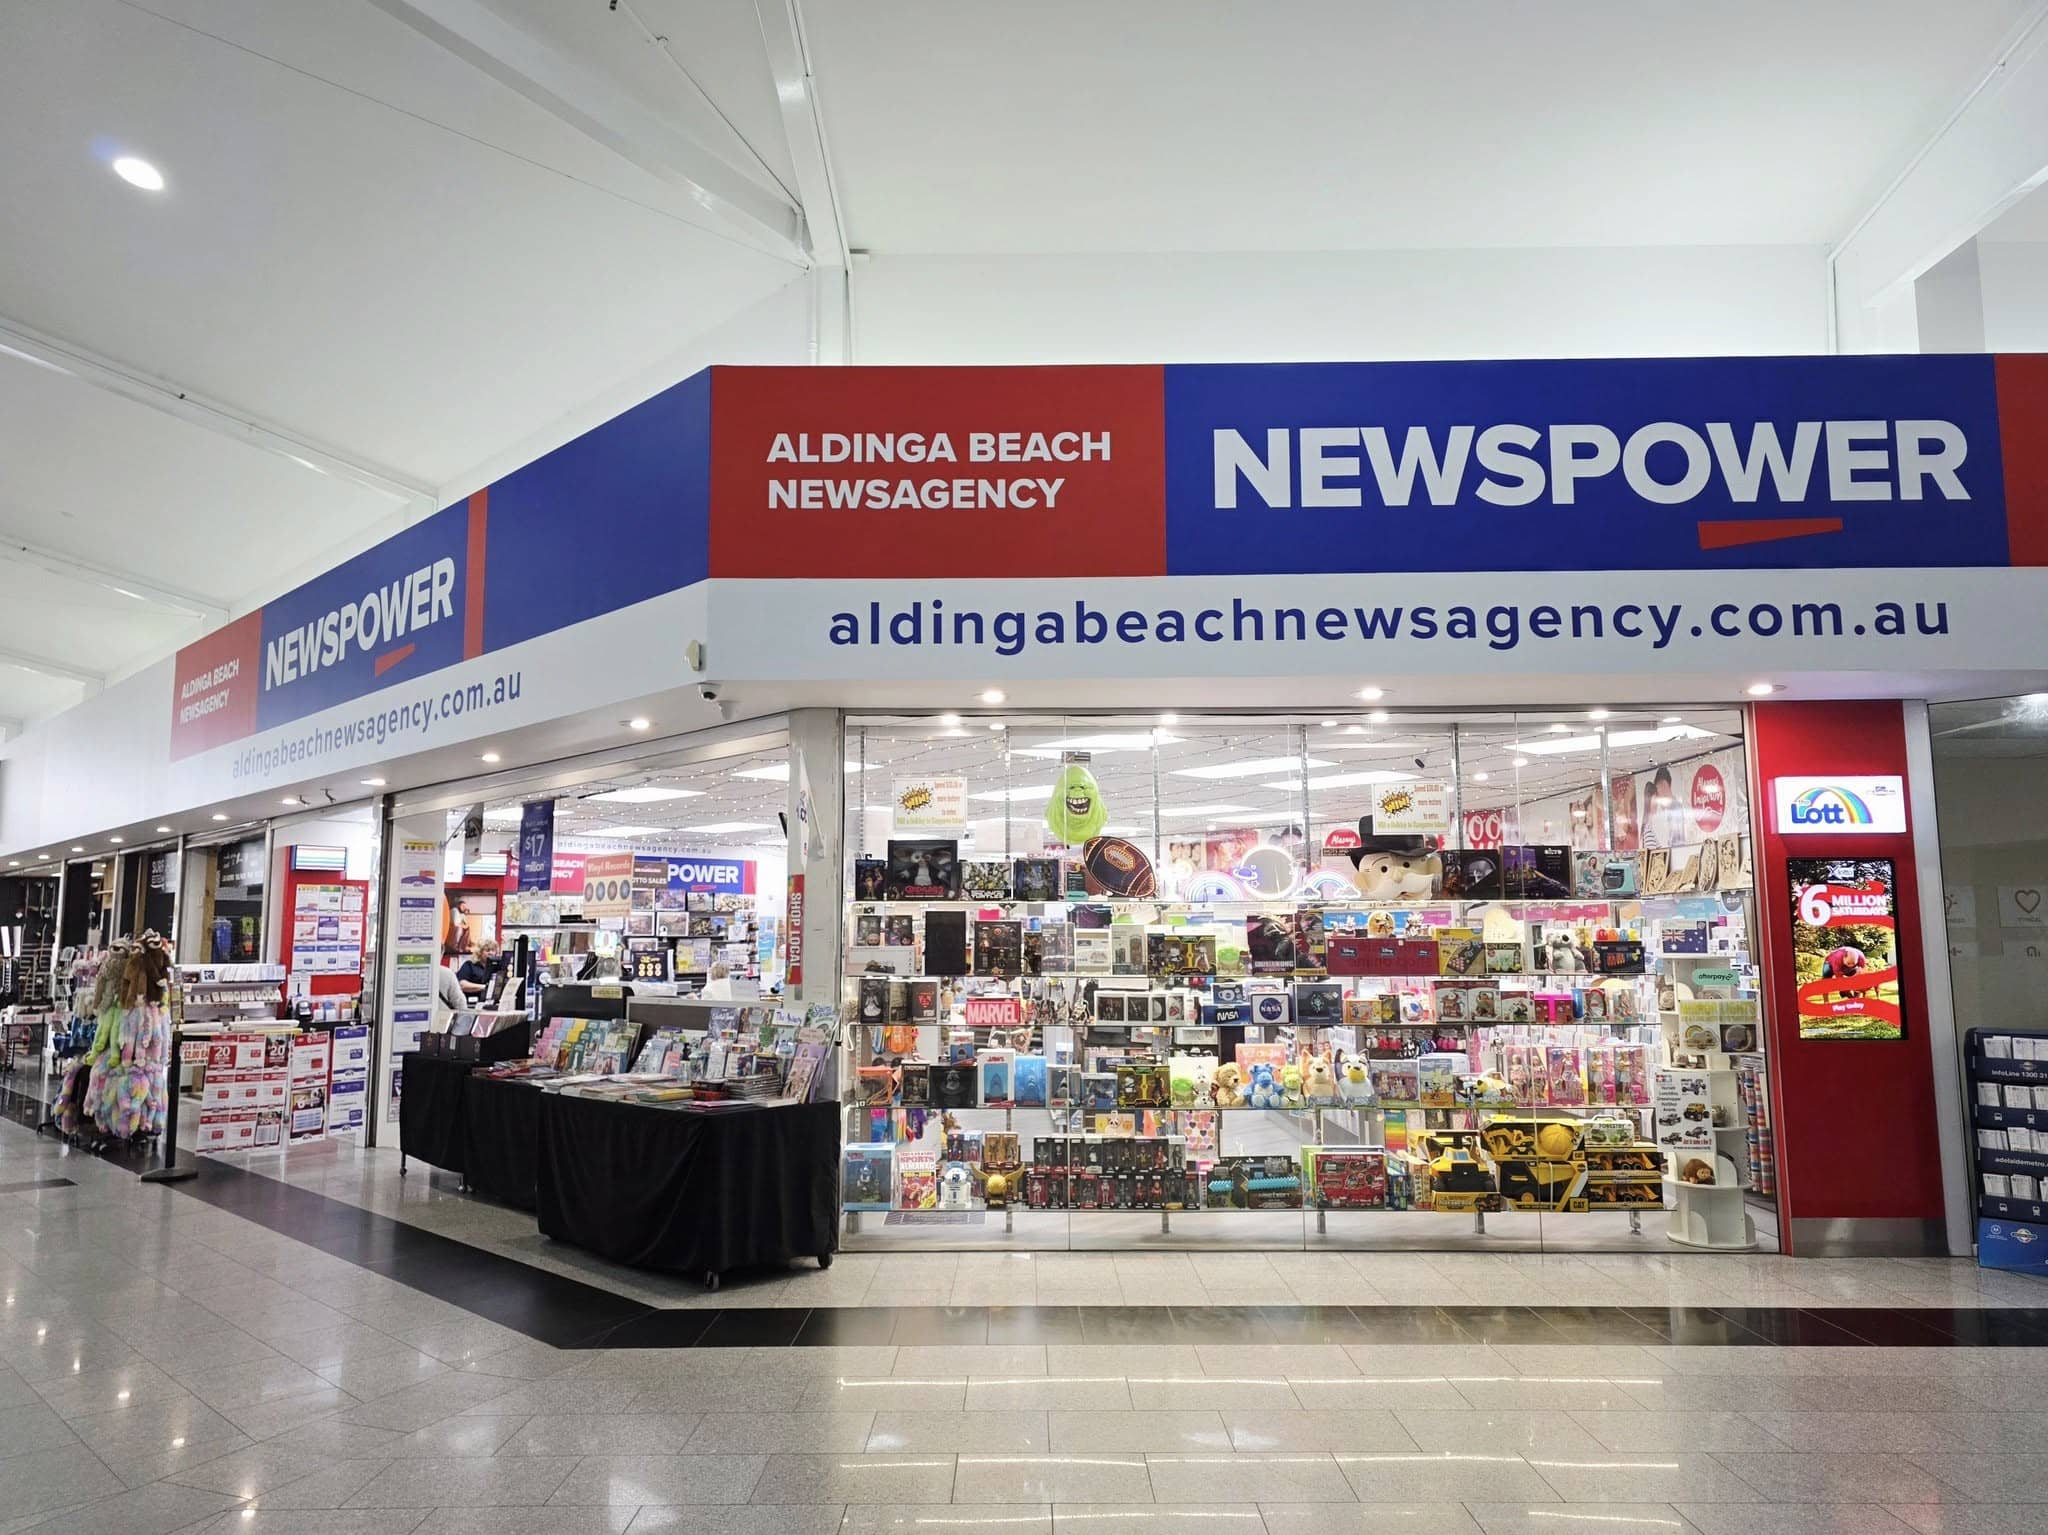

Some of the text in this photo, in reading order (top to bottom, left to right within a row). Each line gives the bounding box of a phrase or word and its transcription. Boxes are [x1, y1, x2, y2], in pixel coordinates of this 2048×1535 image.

[767, 431, 1111, 463] ALDINGA BEACH
[1213, 419, 1971, 509] NEWSPOWER
[768, 478, 1065, 509] NEWSAGENCY
[265, 557, 456, 691] NEWSPOWER
[829, 595, 1950, 656] aldingabeachnewsagency.com.au
[181, 659, 240, 700] ALDINGA BEACH
[180, 689, 230, 724] NEWSAGENCY
[232, 669, 522, 779] aldingabeachnewsagency.com.au
[1791, 803, 1845, 824] Lott
[524, 833, 545, 858] $17
[524, 861, 545, 873] million
[790, 892, 802, 927] SHOP
[1831, 895, 1889, 907] MILLION
[1831, 904, 1889, 915] SATURDAYS
[789, 930, 801, 967] LOCAL
[967, 1003, 1018, 1023] MARVEL
[1217, 1011, 1240, 1022] NASA
[1832, 1001, 1865, 1012] Play today
[1991, 1069, 2020, 1078] InfoLine
[2021, 1070, 2038, 1079] 1300
[1573, 1200, 1585, 1209] CAT
